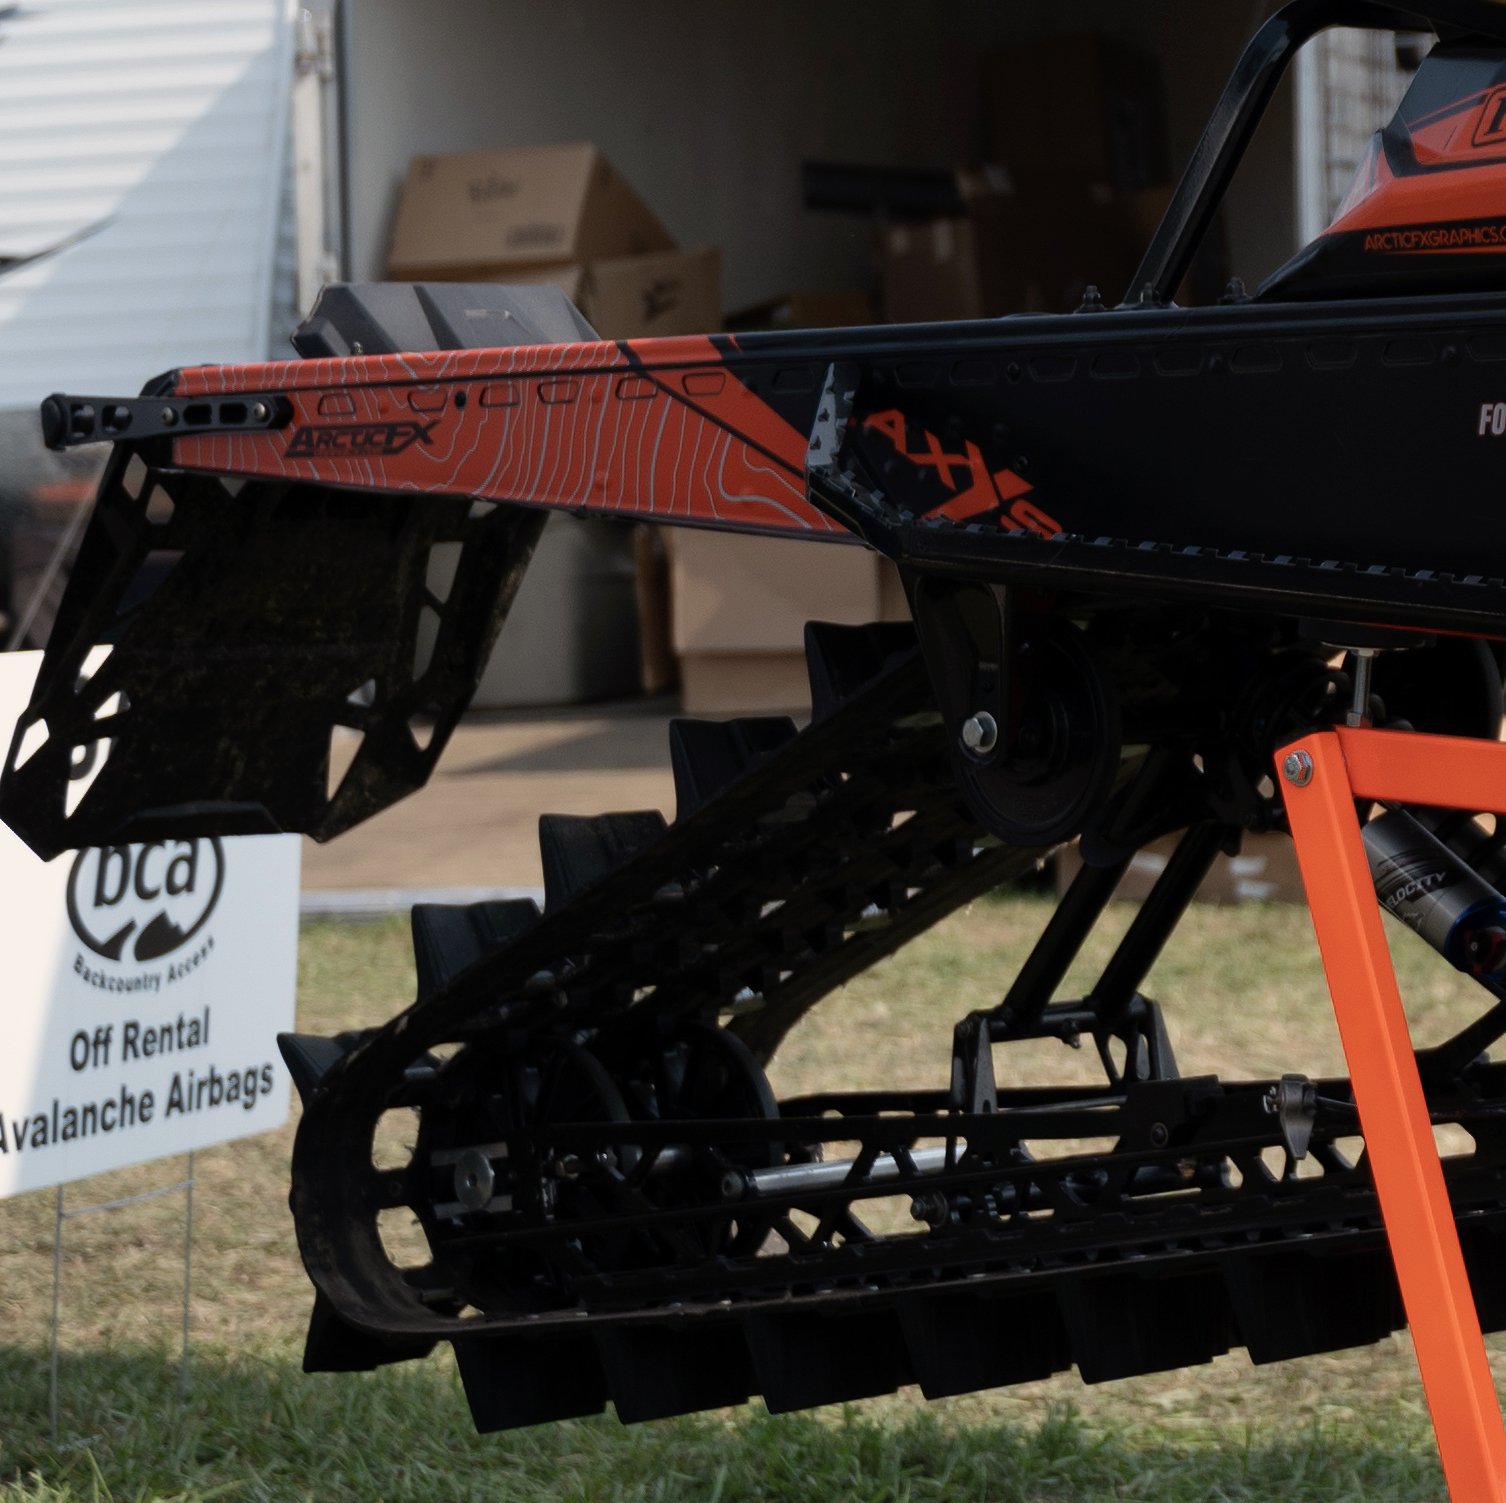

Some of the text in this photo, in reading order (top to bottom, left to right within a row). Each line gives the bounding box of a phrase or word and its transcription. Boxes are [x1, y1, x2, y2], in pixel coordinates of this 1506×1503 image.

[73, 936, 215, 995] Backcountry Access
[70, 1004, 210, 1072] Off Rental
[165, 1061, 275, 1117] Airbags
